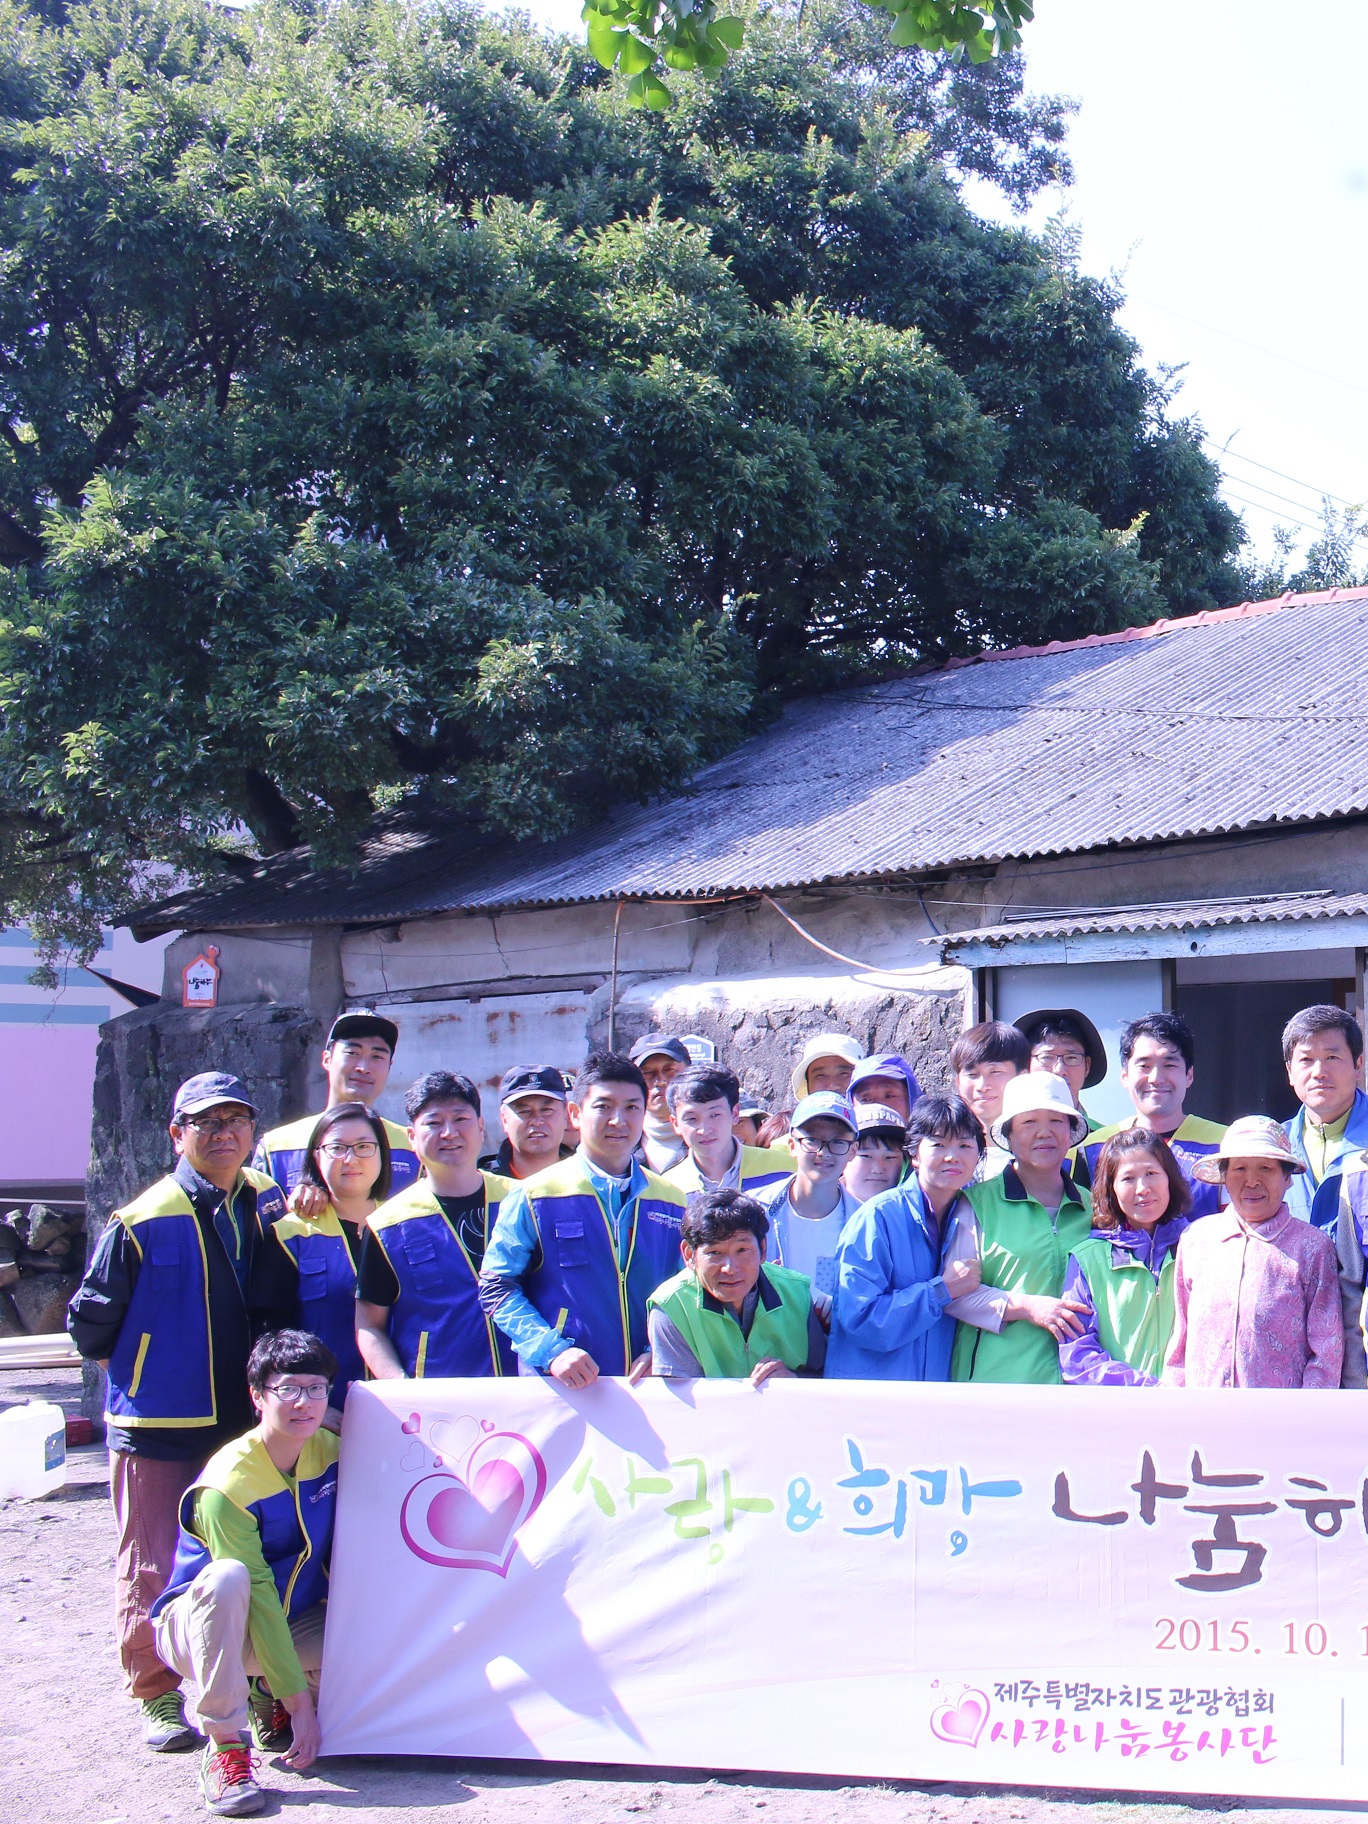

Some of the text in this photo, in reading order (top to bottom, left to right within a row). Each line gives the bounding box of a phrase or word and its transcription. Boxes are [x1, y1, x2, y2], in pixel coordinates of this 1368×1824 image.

[1155, 1618, 1261, 1655] 2015.
[1284, 1622, 1338, 1657] 10.
[991, 1718, 1278, 1764] 사랑나눔봉사단
